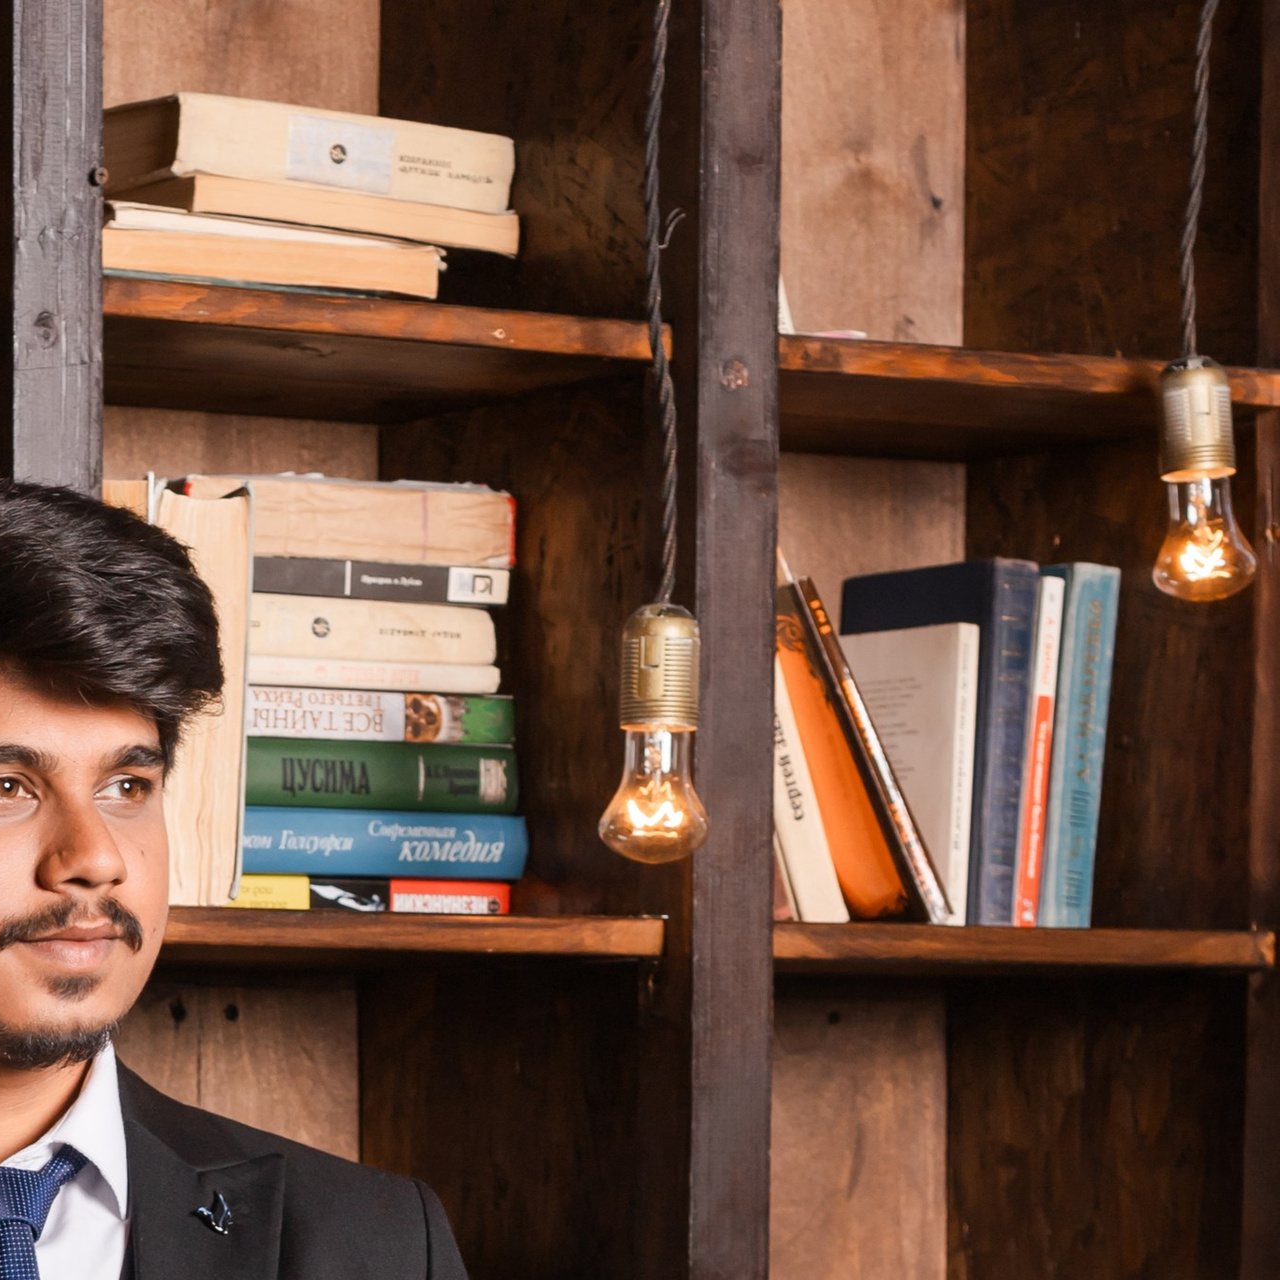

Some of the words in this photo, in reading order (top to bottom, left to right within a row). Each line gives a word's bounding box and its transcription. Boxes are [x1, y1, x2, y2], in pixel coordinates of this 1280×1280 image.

[252, 706, 335, 734] ТАЙНЫ
[344, 712, 384, 734] ВСЕ
[281, 757, 370, 796] ЦУСИМА
[398, 830, 505, 864] комедия
